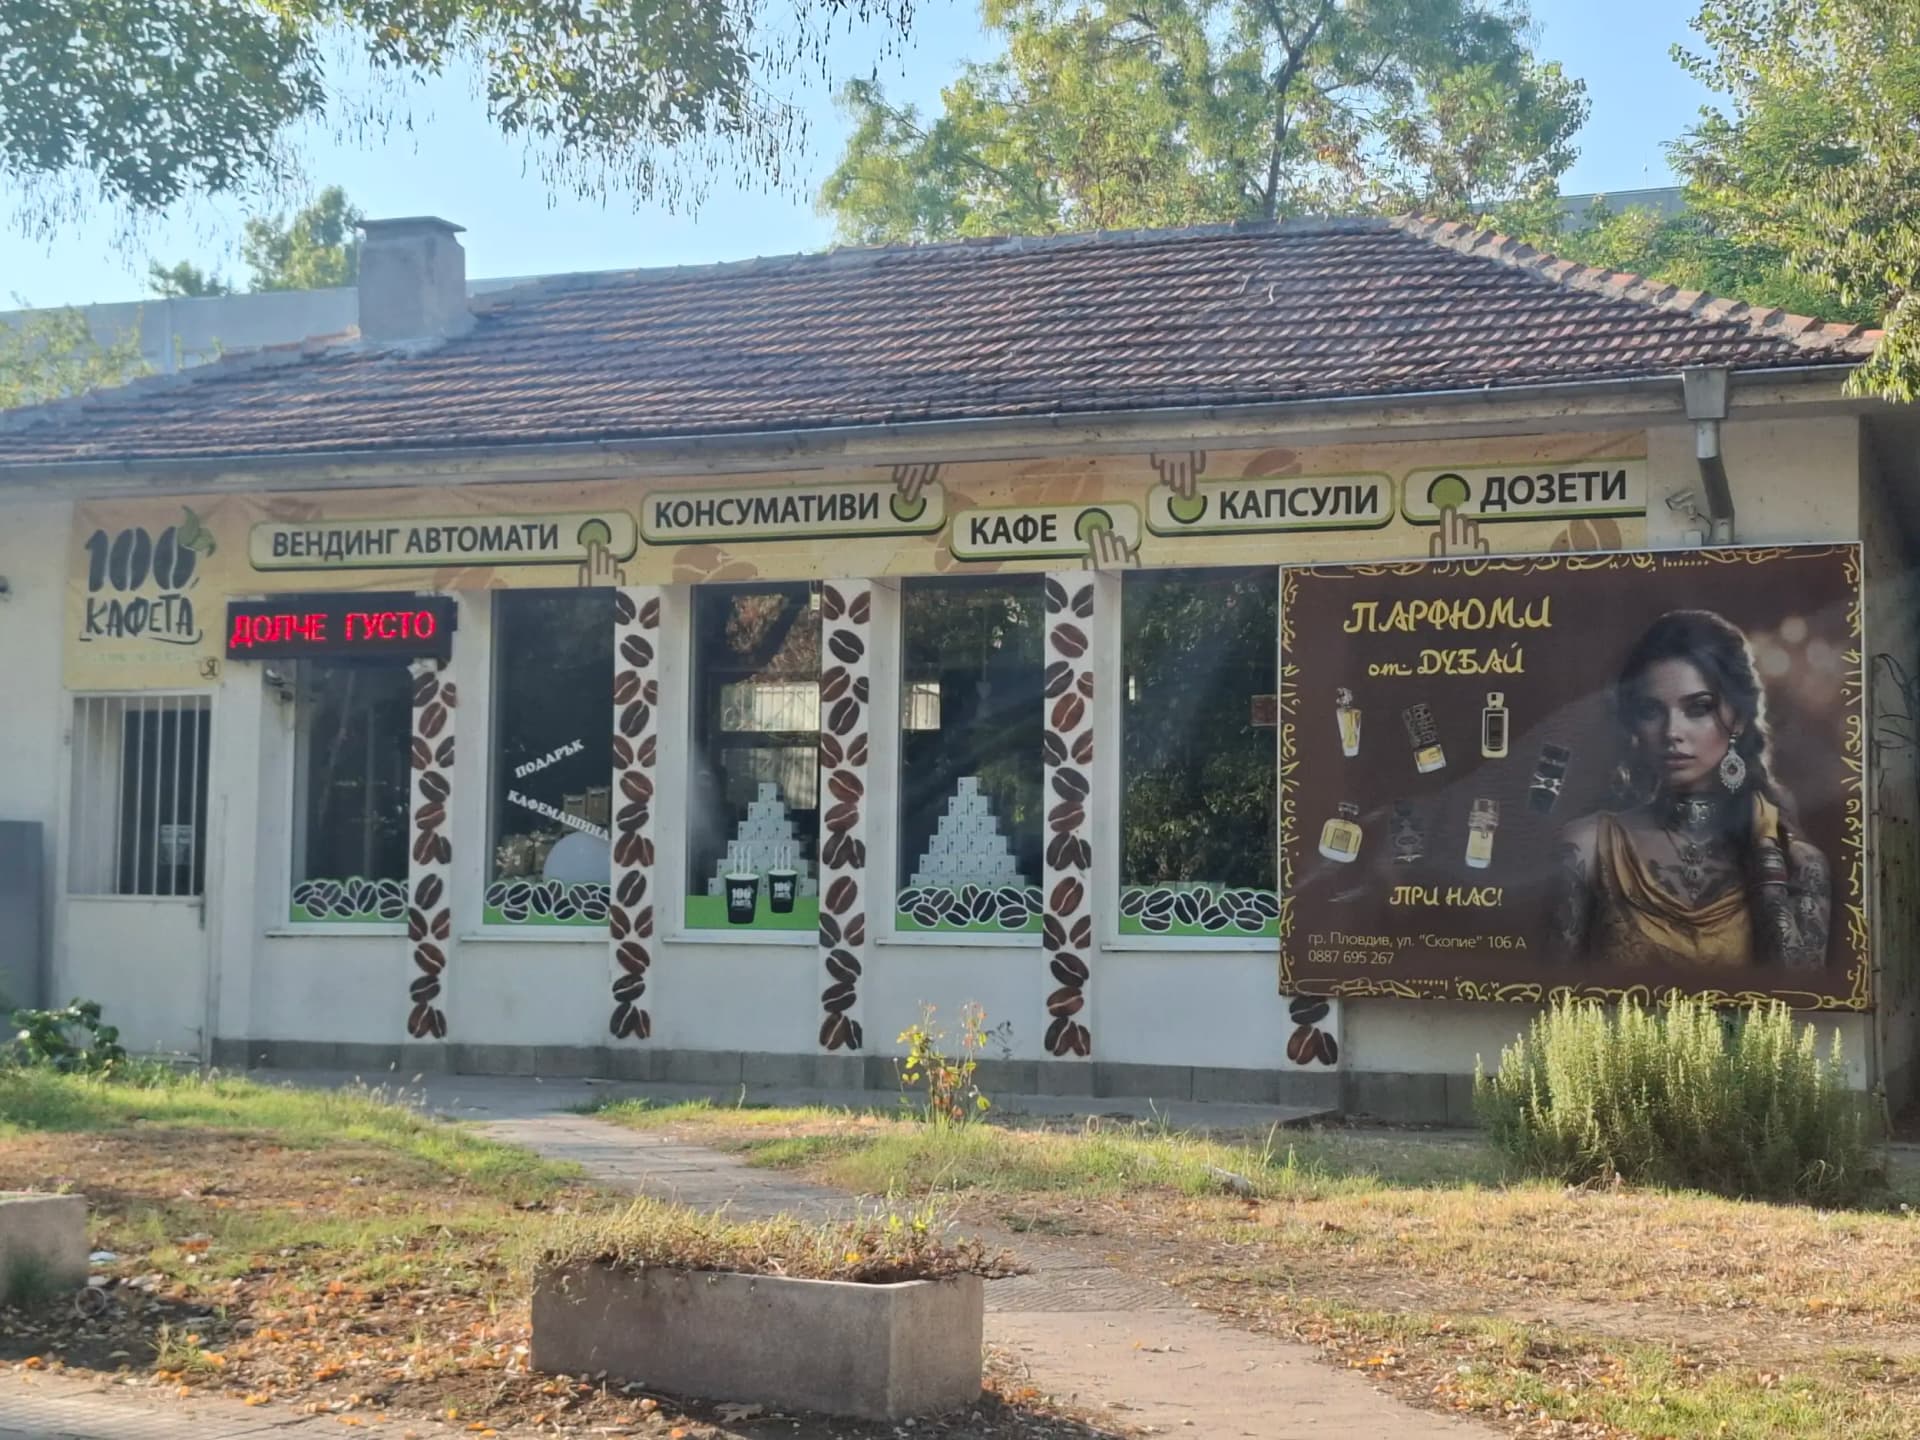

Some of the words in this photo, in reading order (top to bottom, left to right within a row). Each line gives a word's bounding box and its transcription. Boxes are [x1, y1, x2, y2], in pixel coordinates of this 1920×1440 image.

[1219, 484, 1379, 519] КАПСУЛИ
[1480, 469, 1627, 510] ДОЗЕТИ
[655, 492, 879, 528] КОНСУМАТИВИ
[273, 528, 400, 561] ВЕНДИНГ
[405, 524, 558, 554] АВТОМАТИ
[971, 514, 1057, 545] КАФЕ
[84, 526, 198, 592] 100
[85, 594, 194, 639] КАФЕТА
[229, 613, 329, 649] ДОЛЧЕ
[345, 610, 436, 641] ГУСТО
[1343, 595, 1553, 633] ПАРФЮМИ
[1368, 663, 1412, 676] от
[1417, 641, 1526, 675] ДУБАЙ
[514, 739, 585, 779] ПОДАРЪК
[507, 789, 610, 841] КАФЕМАШИНА
[1389, 885, 1440, 907] ПРИ
[1445, 886, 1503, 907] НАС!
[1308, 935, 1326, 948] гр.
[1330, 931, 1393, 948] Пловдив,
[1396, 935, 1415, 949] ул.
[1487, 935, 1513, 949] 106
[1308, 950, 1339, 963] 0887
[1343, 950, 1367, 964] 695
[1371, 950, 1394, 965] 267
